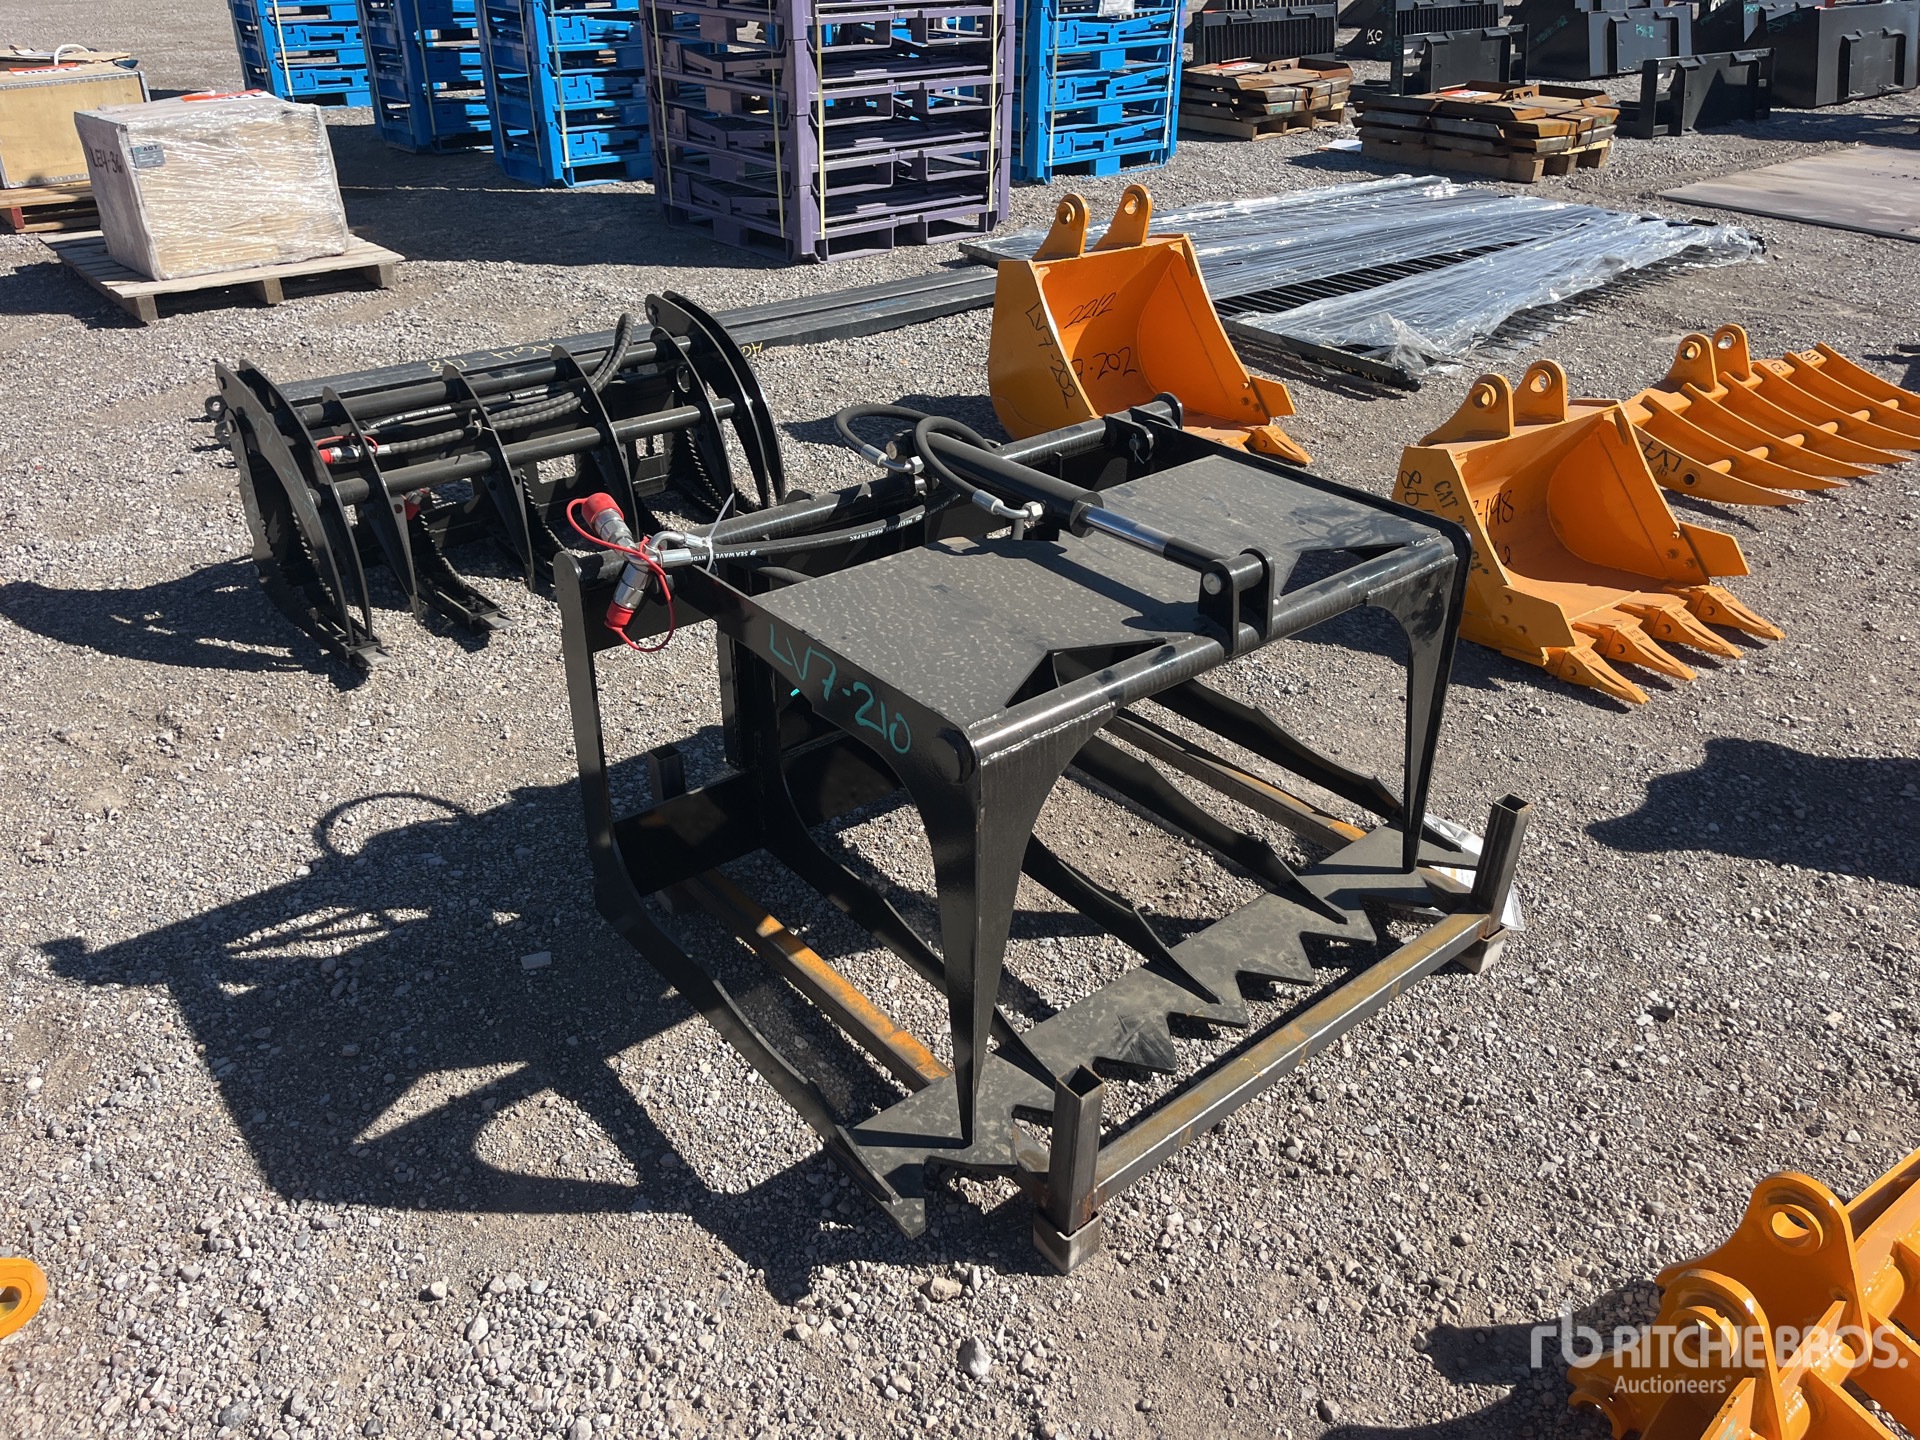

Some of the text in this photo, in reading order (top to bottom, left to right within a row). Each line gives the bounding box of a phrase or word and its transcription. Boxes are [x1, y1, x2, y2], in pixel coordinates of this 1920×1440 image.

[1366, 28, 1383, 43] KC
[1063, 291, 1117, 330] 2212
[1433, 480, 1459, 509] CAT
[715, 552, 736, 560] WAVE
[769, 623, 912, 754] LV7-210
